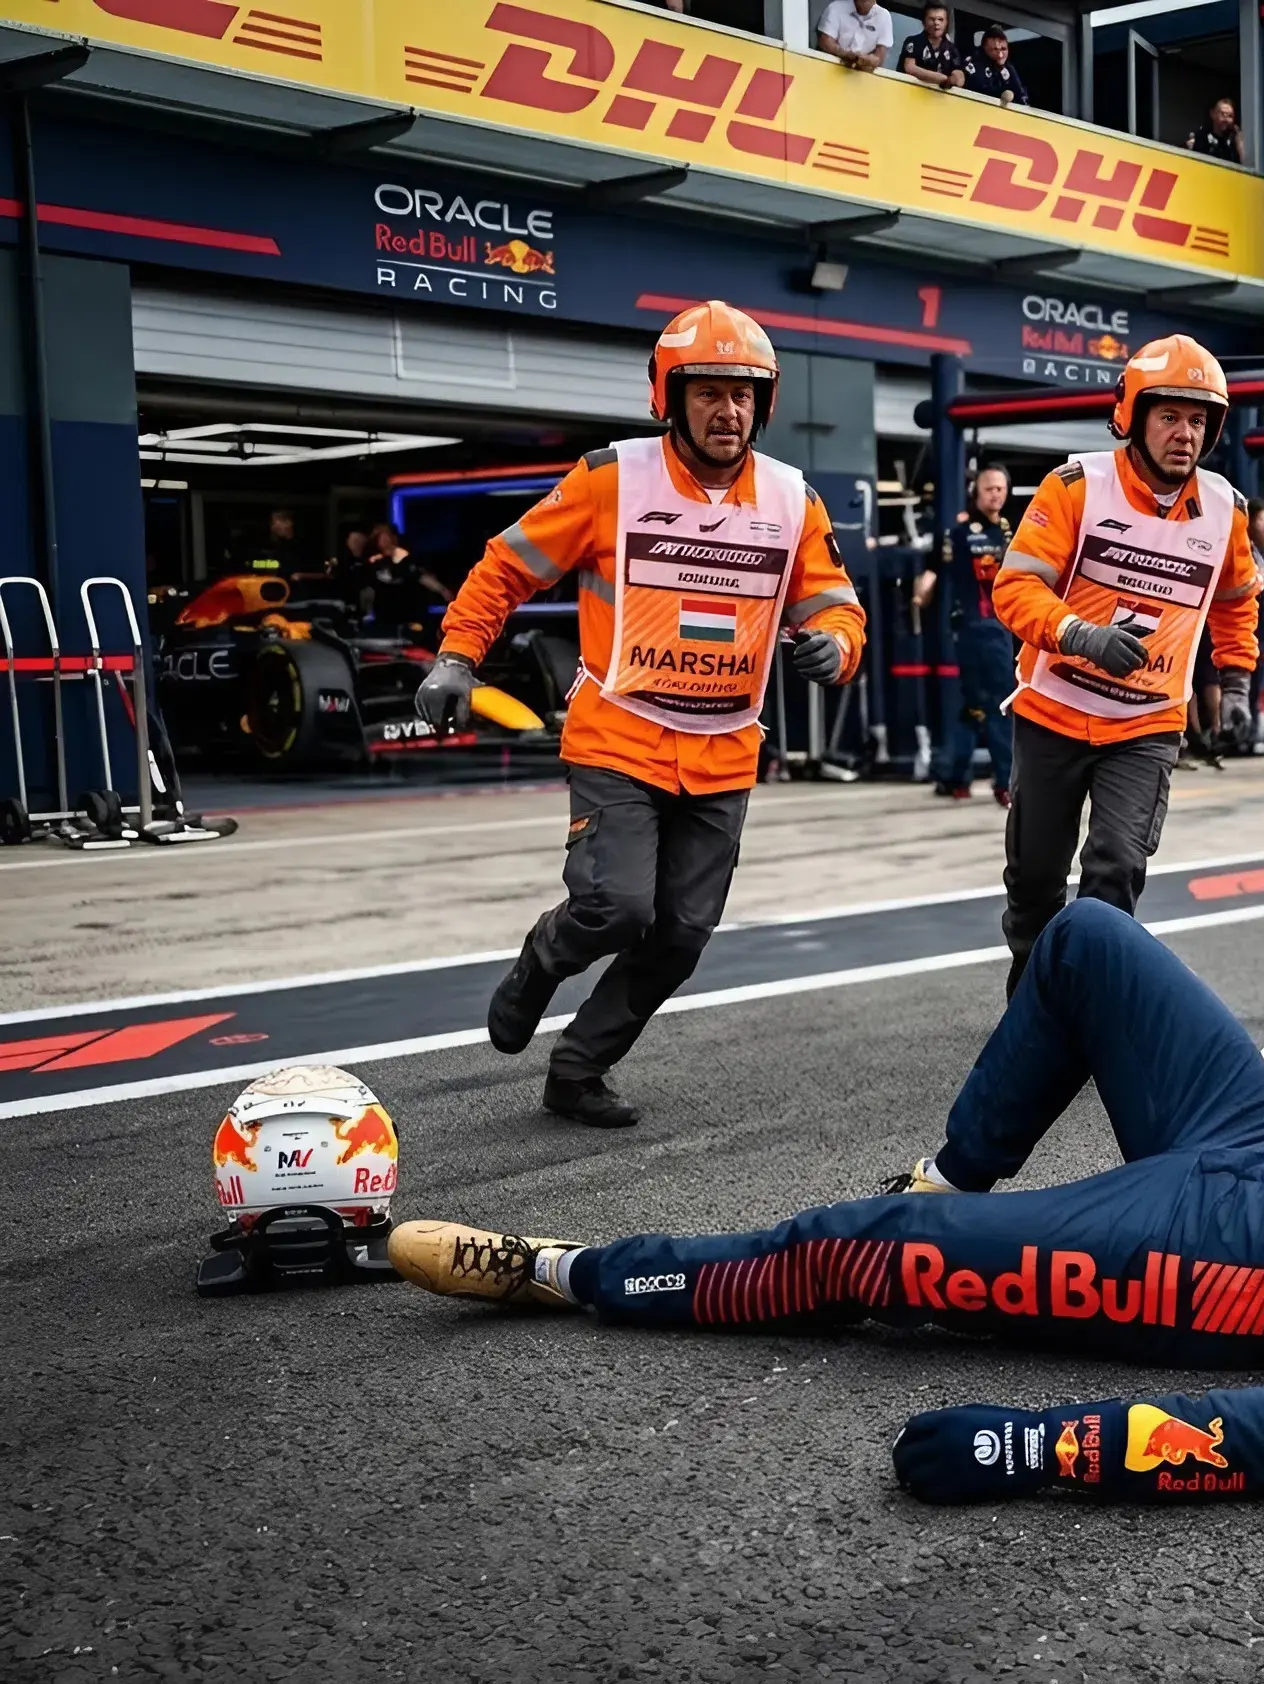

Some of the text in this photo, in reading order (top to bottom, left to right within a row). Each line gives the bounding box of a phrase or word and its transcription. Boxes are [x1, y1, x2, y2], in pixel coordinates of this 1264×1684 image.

[480, 2, 816, 166] DHL
[969, 125, 1192, 246] DHL
[374, 184, 554, 239] ORACLE
[375, 223, 477, 264] Red Bull
[377, 267, 557, 309] RACING
[917, 285, 942, 328] 1
[1022, 295, 1129, 335] ORACLE
[1023, 358, 1111, 384] RACIN
[901, 1241, 1182, 1328] Red Bull
